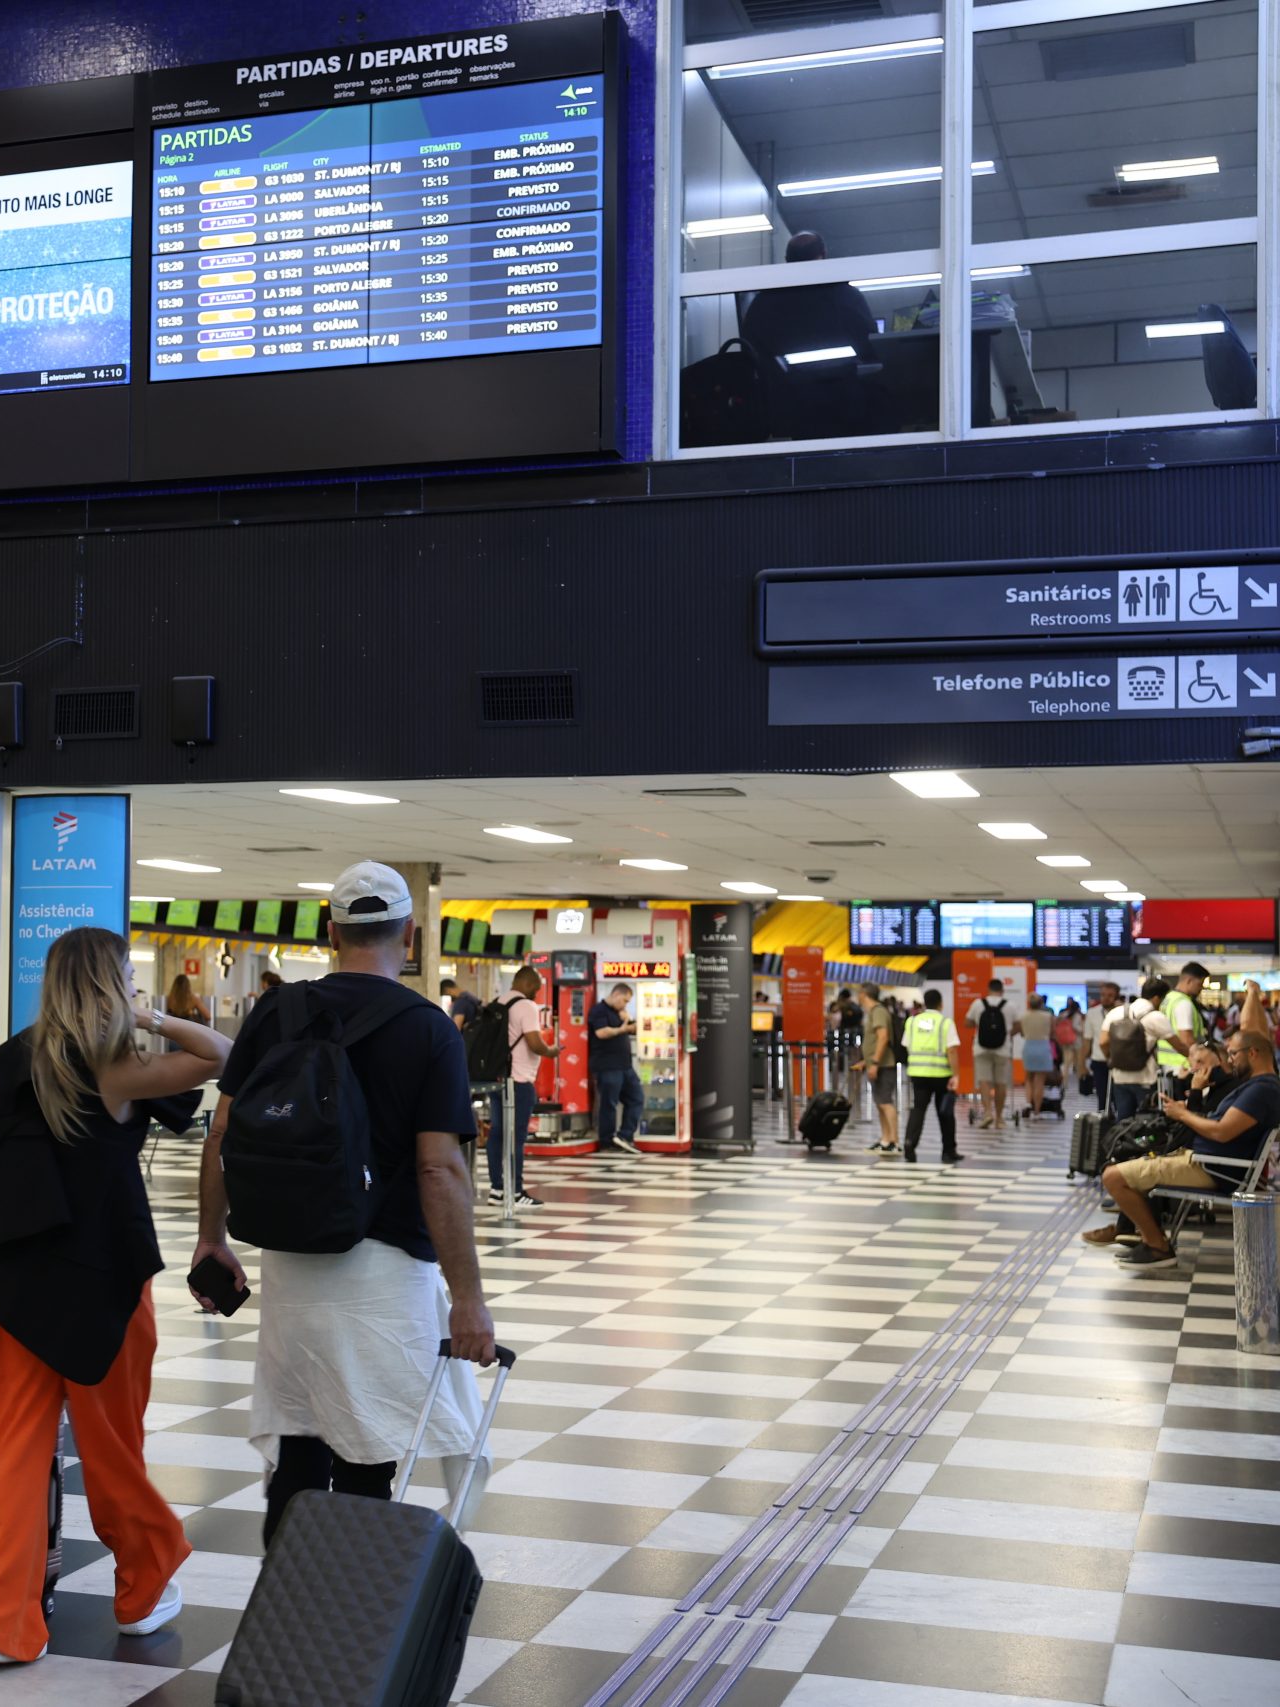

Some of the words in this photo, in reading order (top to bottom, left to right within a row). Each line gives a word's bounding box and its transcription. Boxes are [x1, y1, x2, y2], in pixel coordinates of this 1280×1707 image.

[235, 53, 341, 86] PARTIDAS
[346, 52, 353, 71] /
[360, 32, 508, 70] DEPARTURES
[151, 101, 178, 113] previsto
[184, 97, 208, 108] destino
[258, 88, 285, 100] escalas
[333, 79, 364, 91] empresa
[369, 78, 382, 86] voo
[395, 71, 419, 84] portão
[422, 66, 462, 79] confirmado
[469, 59, 516, 74] observações
[151, 110, 181, 121] schedule
[183, 105, 220, 117] destination
[258, 99, 269, 108] via
[333, 89, 355, 99] airline
[369, 85, 387, 96] flight
[395, 82, 412, 93] gate
[422, 76, 458, 88] confirmed
[469, 71, 499, 82] remarks
[159, 122, 253, 153] PARTIDAS
[157, 174, 178, 184] HORA
[213, 167, 240, 178] AIRLINE
[263, 161, 288, 172] FLIGHT
[312, 156, 329, 166] CITY
[418, 141, 461, 155] ESTIMATED
[519, 130, 549, 143] STATUS
[493, 146, 521, 161] EMB.
[522, 138, 575, 158] PRÓXIMO
[159, 152, 186, 167] Página
[187, 151, 194, 162] 2
[421, 155, 449, 169] 15:10
[493, 166, 520, 180] EMB.
[522, 158, 574, 176] PRÓXIMO
[313, 182, 370, 200] SALVADOR
[507, 181, 560, 197] PREVISTO
[24, 192, 62, 212] MAIS
[65, 186, 113, 208] LONGE
[421, 193, 449, 207] 15:15
[314, 198, 383, 219] UBERLÂNDIA
[496, 200, 570, 218] CONFIRMADO
[314, 222, 350, 237] PORTO
[351, 218, 393, 233] ALEGRE
[495, 221, 571, 239] CONFIRMADO
[421, 233, 449, 247] 15:20
[492, 245, 519, 258] EMB.
[521, 238, 573, 256] PRÓXIMO
[313, 259, 369, 276] SALVADOR
[506, 261, 558, 276] PREVISTO
[313, 281, 349, 295] PORTO
[350, 276, 392, 292] ALEGRE
[421, 271, 448, 285] 15:30
[506, 280, 558, 296] PREVISTO
[312, 297, 359, 314] GOIÂNIA
[506, 300, 558, 315] PREVISTO
[312, 315, 359, 332] GOIÂNIA
[420, 310, 448, 323] 15:40
[506, 319, 558, 334] PREVISTO
[92, 367, 123, 380] 14:10
[1005, 584, 1112, 604] Sanitários
[1029, 611, 1112, 627] Restrooms
[932, 673, 1023, 693] Telefone
[1029, 670, 1111, 689] Público
[1028, 698, 1111, 716] Telephone
[32, 858, 97, 871] LATAM
[19, 904, 94, 918] Assistência
[19, 927, 32, 938] no
[702, 934, 738, 942] LATAM
